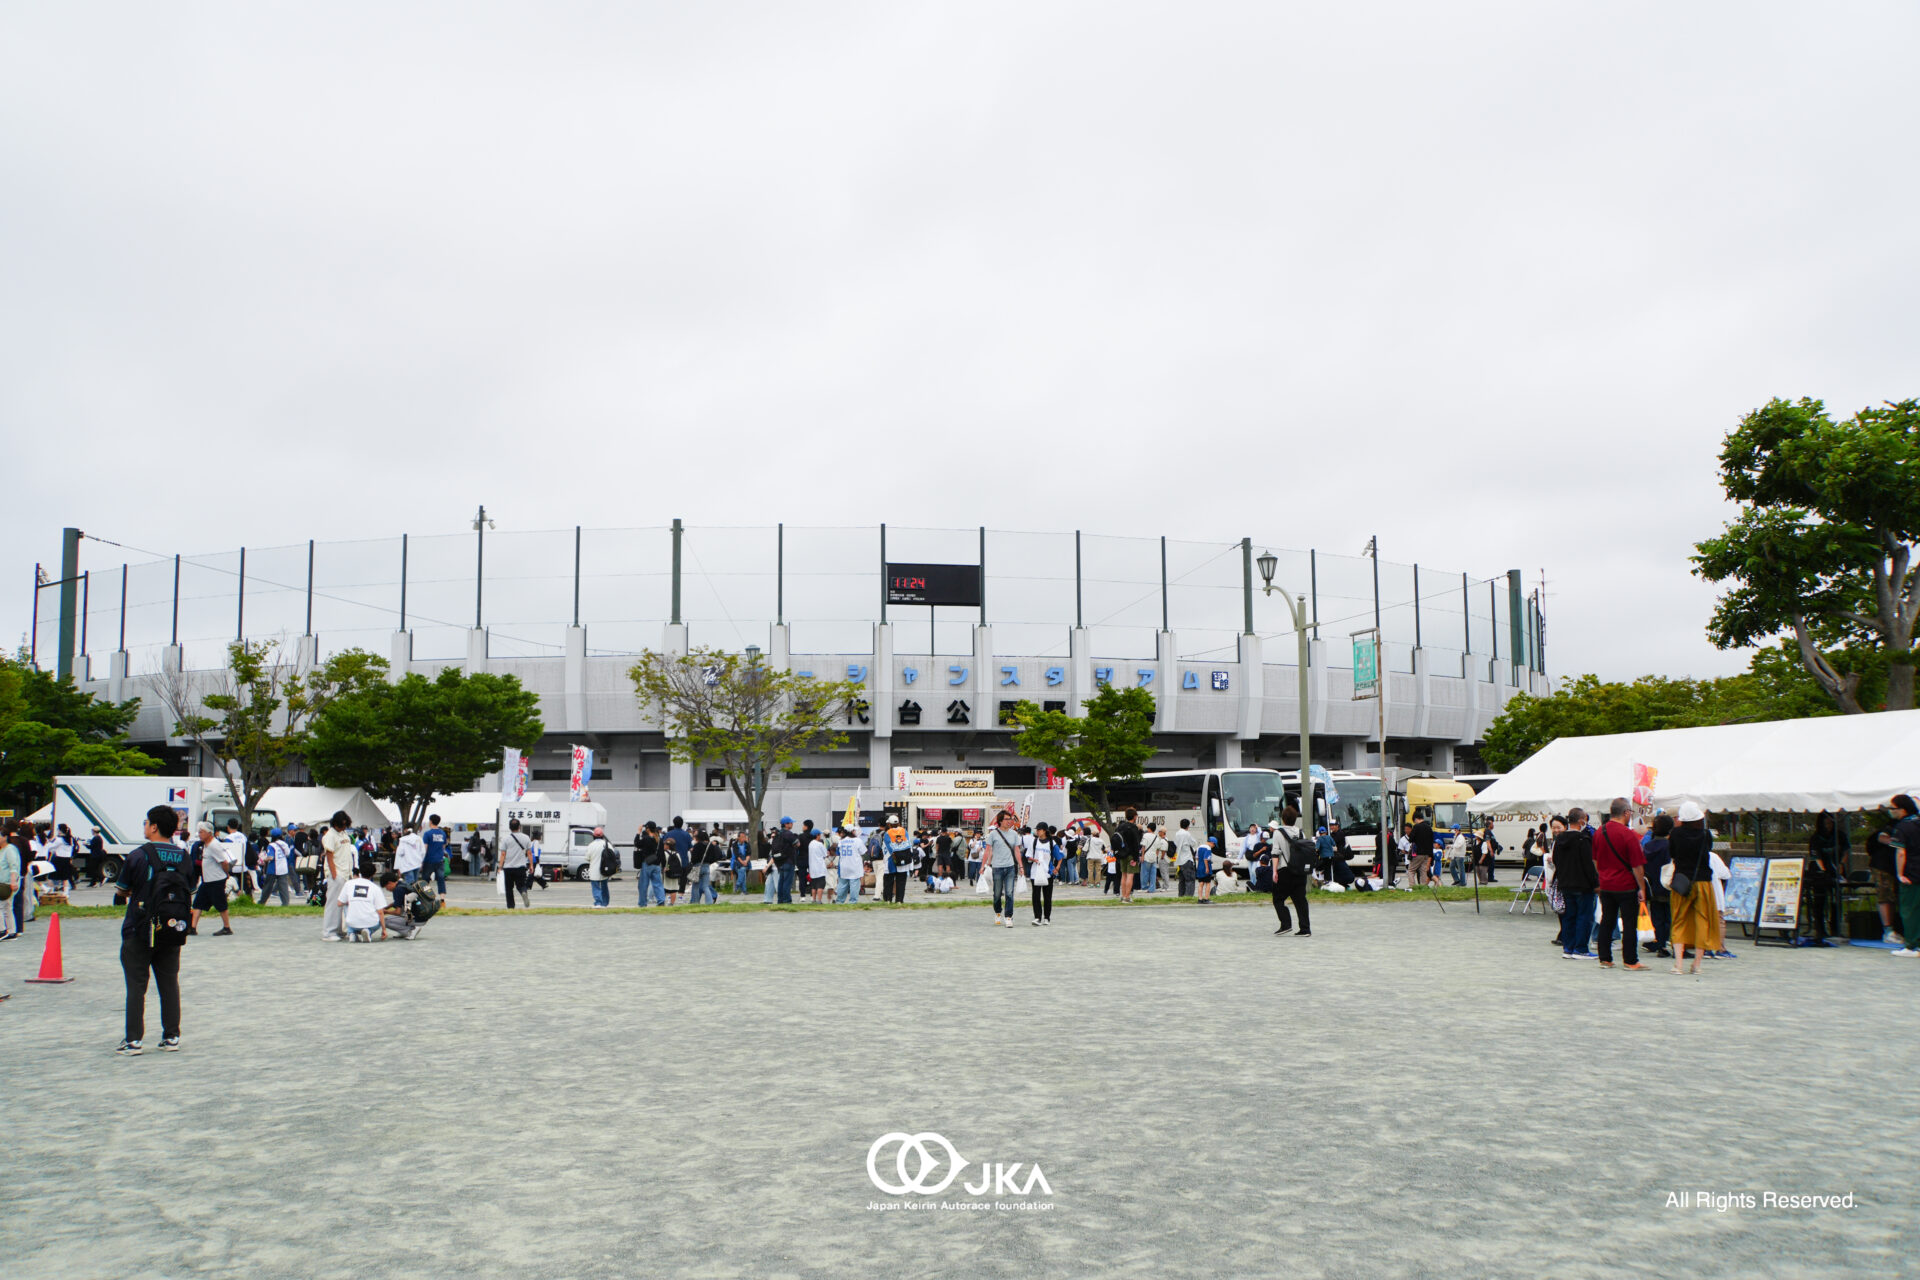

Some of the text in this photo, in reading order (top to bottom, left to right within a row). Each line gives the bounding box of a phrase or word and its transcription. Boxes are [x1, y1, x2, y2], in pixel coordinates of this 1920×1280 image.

[508, 810, 561, 819] なまら珈琲店
[1519, 813, 1538, 822] BUS
